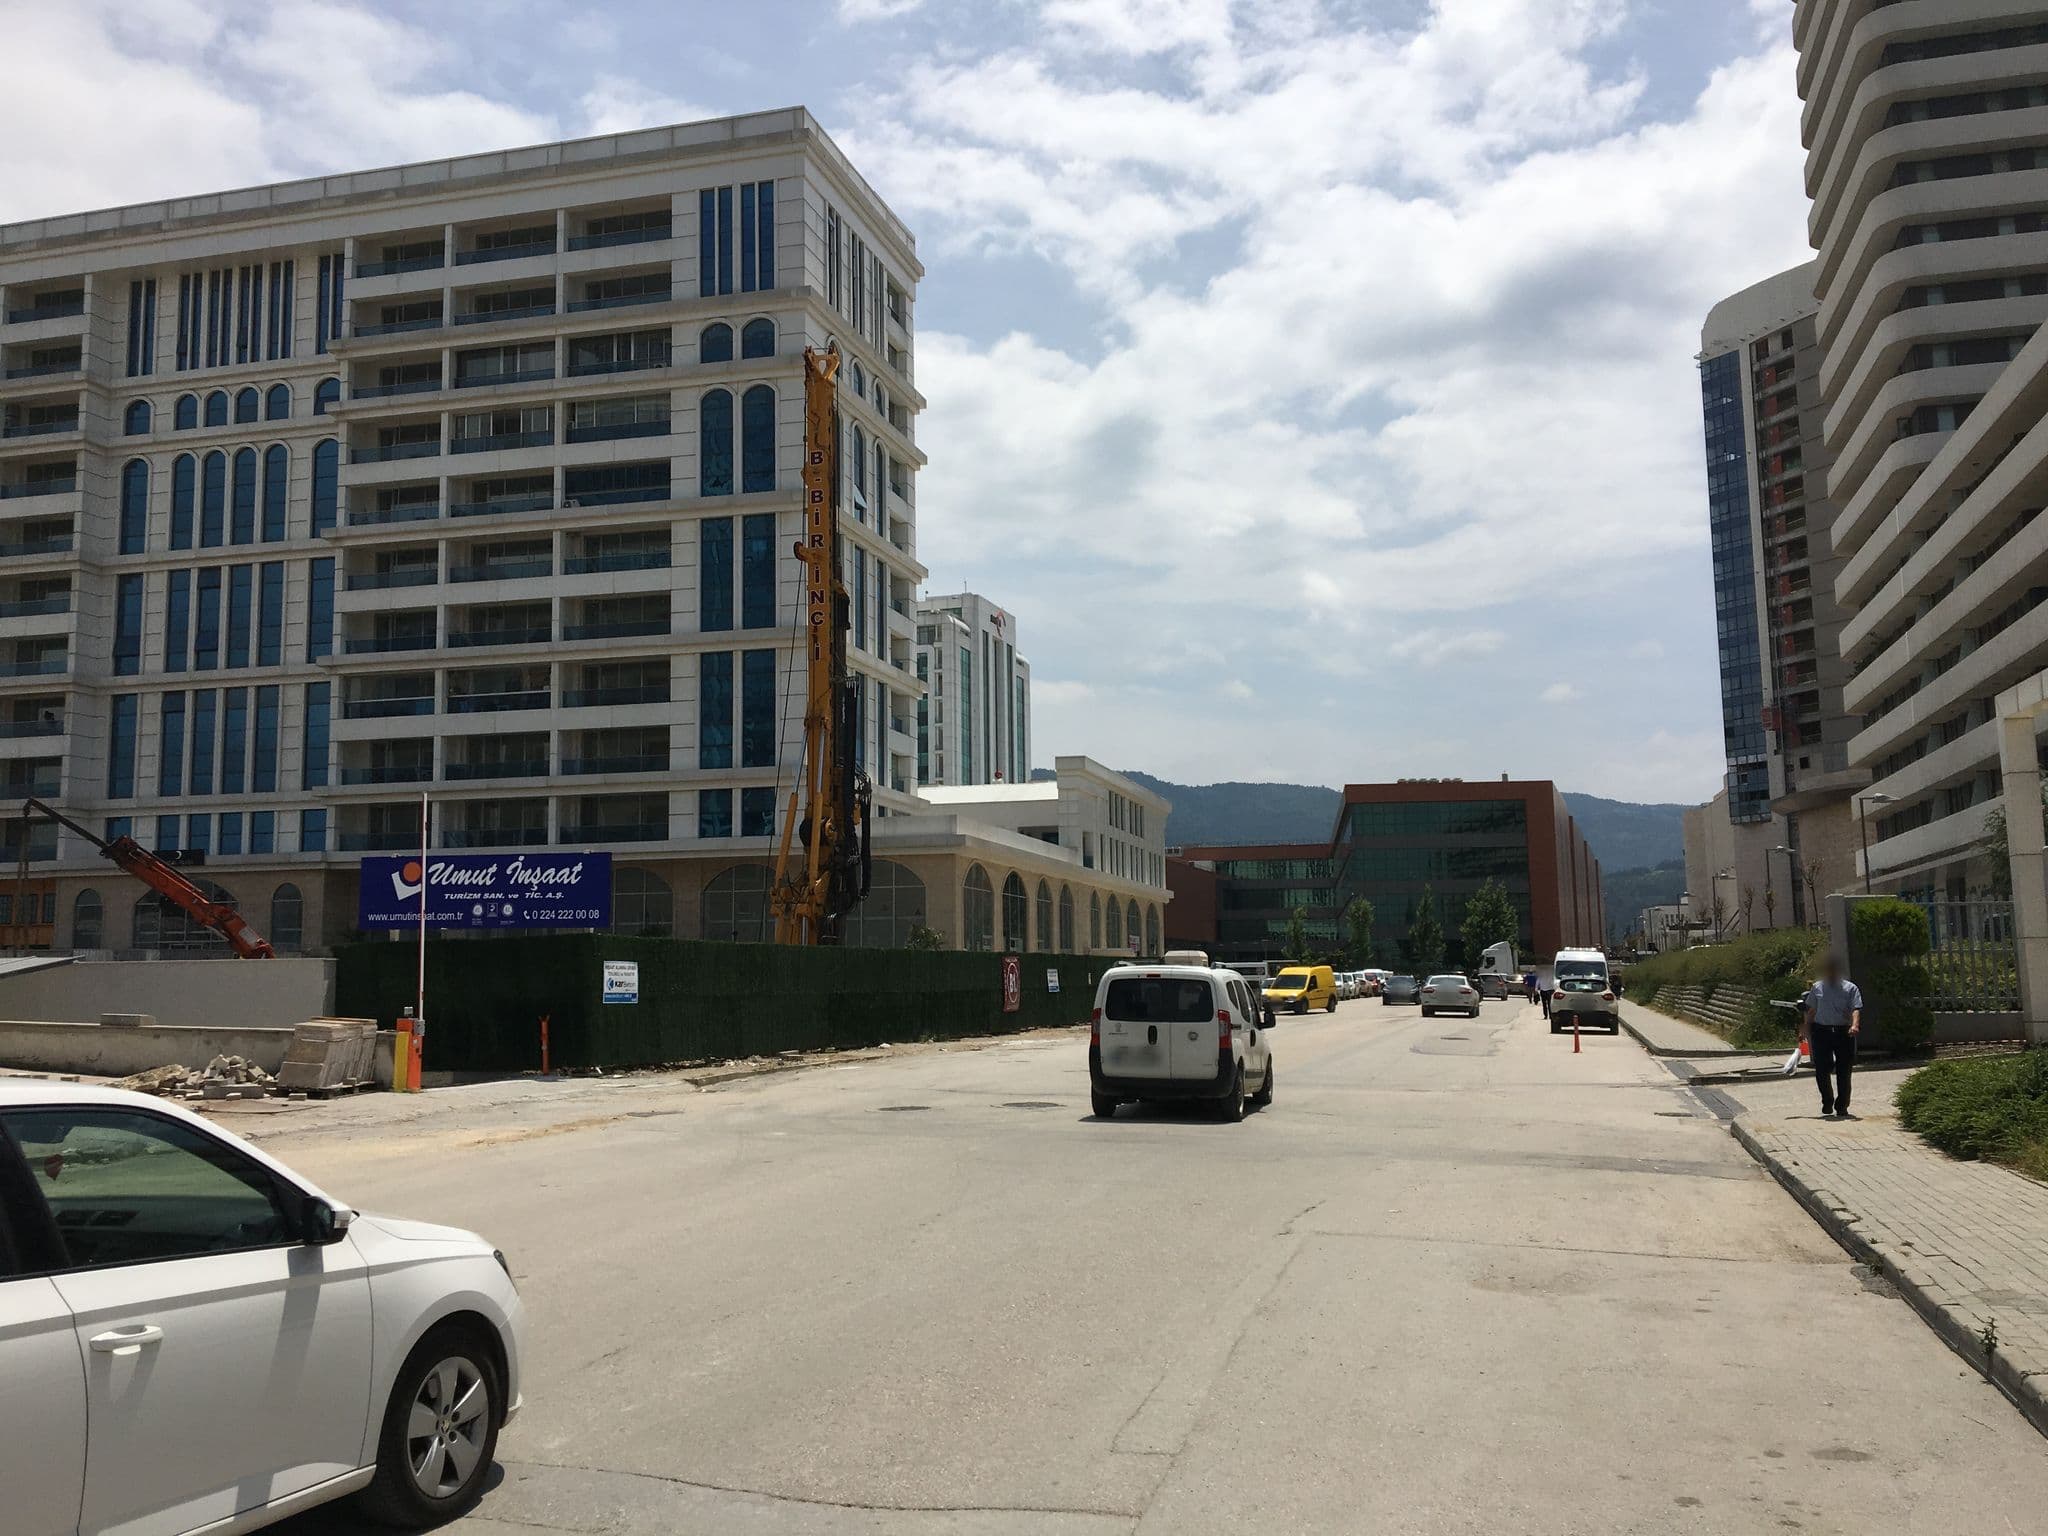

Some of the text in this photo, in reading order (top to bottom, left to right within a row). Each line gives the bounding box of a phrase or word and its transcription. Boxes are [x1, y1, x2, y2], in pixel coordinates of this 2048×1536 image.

[428, 855, 583, 891] Umut İnşaat
[444, 891, 481, 900] TURİZM
[525, 891, 543, 899] TİC.
[545, 891, 565, 900] A.Ş.
[367, 911, 464, 921] www.umutinsat.com.tr
[532, 909, 600, 920] 0 224 222 00 08
